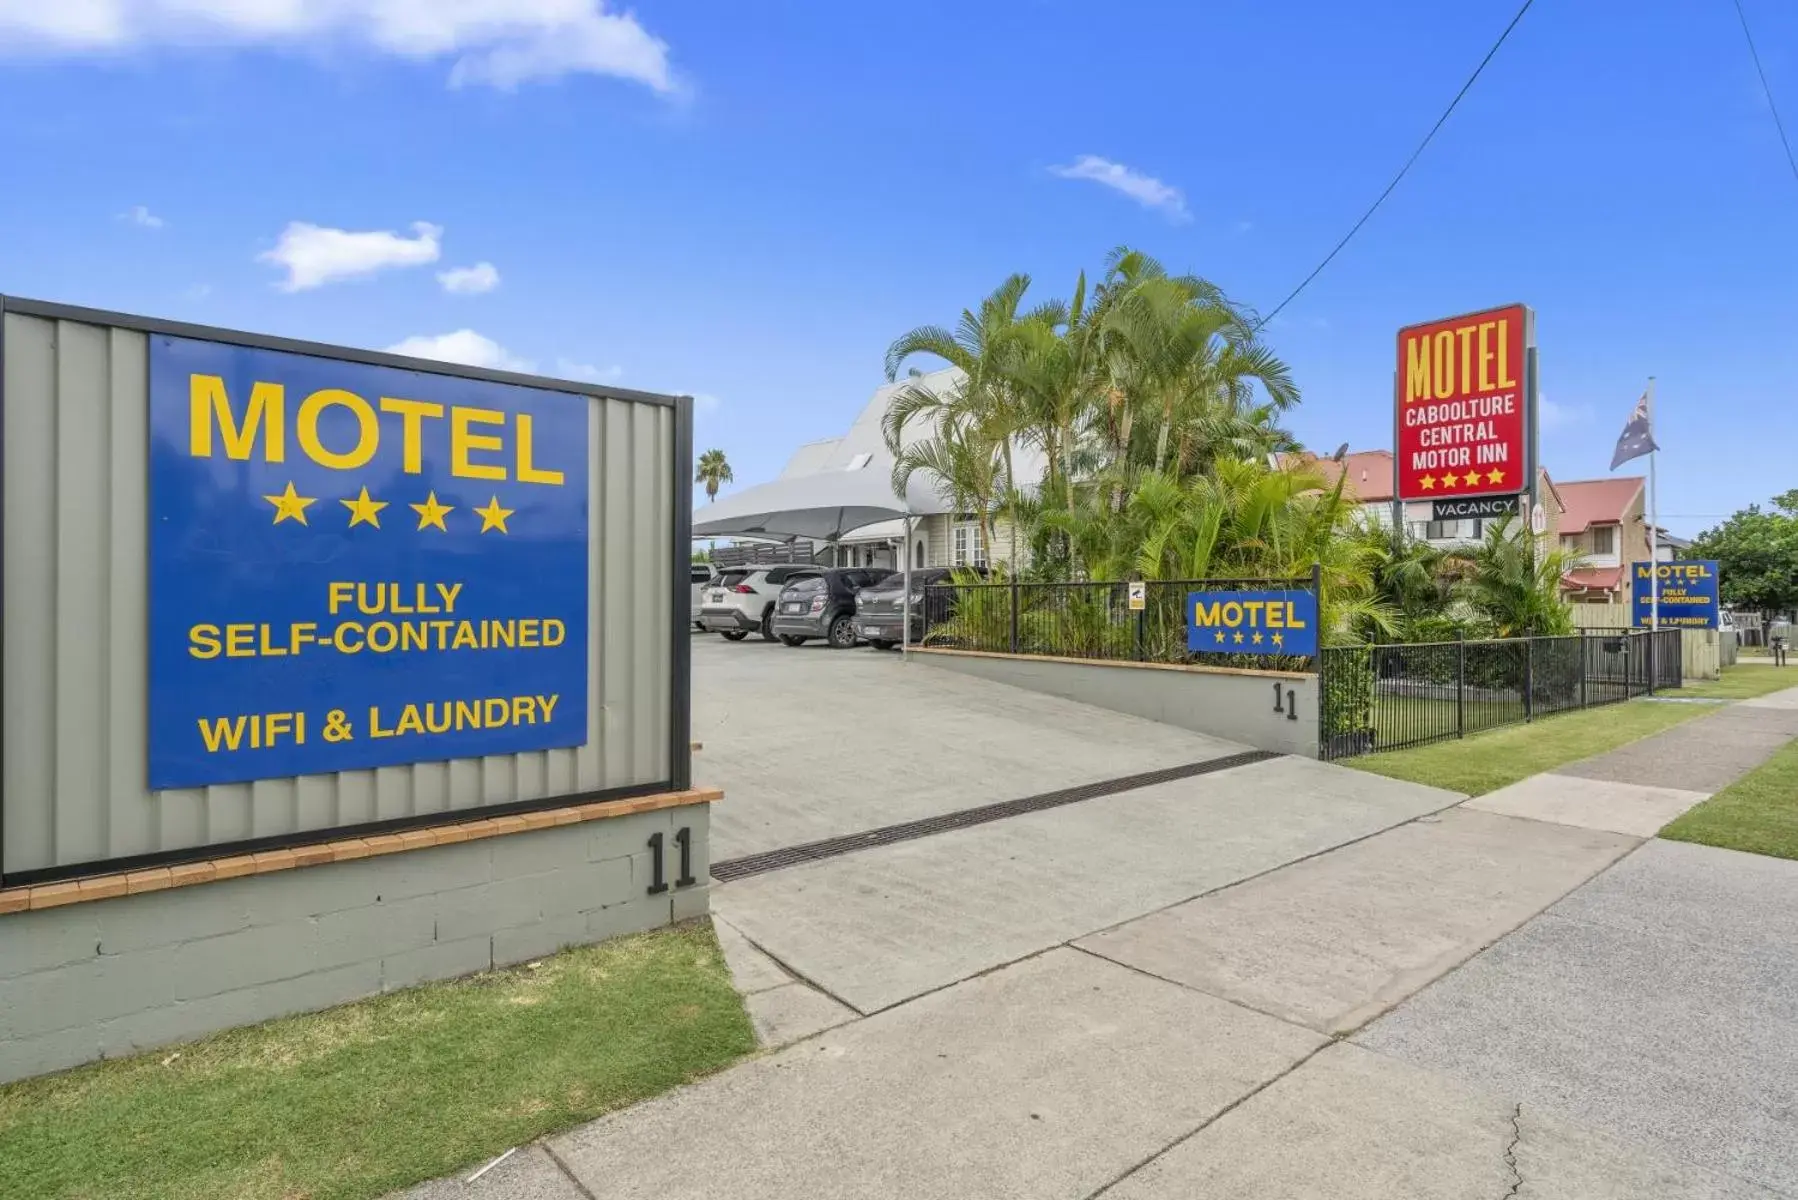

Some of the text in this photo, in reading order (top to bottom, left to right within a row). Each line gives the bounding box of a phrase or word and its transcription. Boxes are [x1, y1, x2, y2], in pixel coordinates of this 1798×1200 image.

[1406, 320, 1516, 402] MOTEL
[1406, 394, 1515, 427] CABOOLTURE
[190, 373, 565, 486] MOTEL
[1420, 421, 1498, 447] CENTRAL
[1413, 443, 1507, 470] MOTOR INN
[1436, 500, 1514, 516] VACANCY
[1638, 565, 1712, 578] MOTEL
[328, 582, 462, 614] FULLY
[1196, 601, 1305, 628] MOTEL
[189, 619, 565, 658] SELF-CONTAINED
[1273, 682, 1298, 720] 11
[198, 695, 559, 752] WIFI & LAUNDRY
[646, 827, 696, 895] 11
